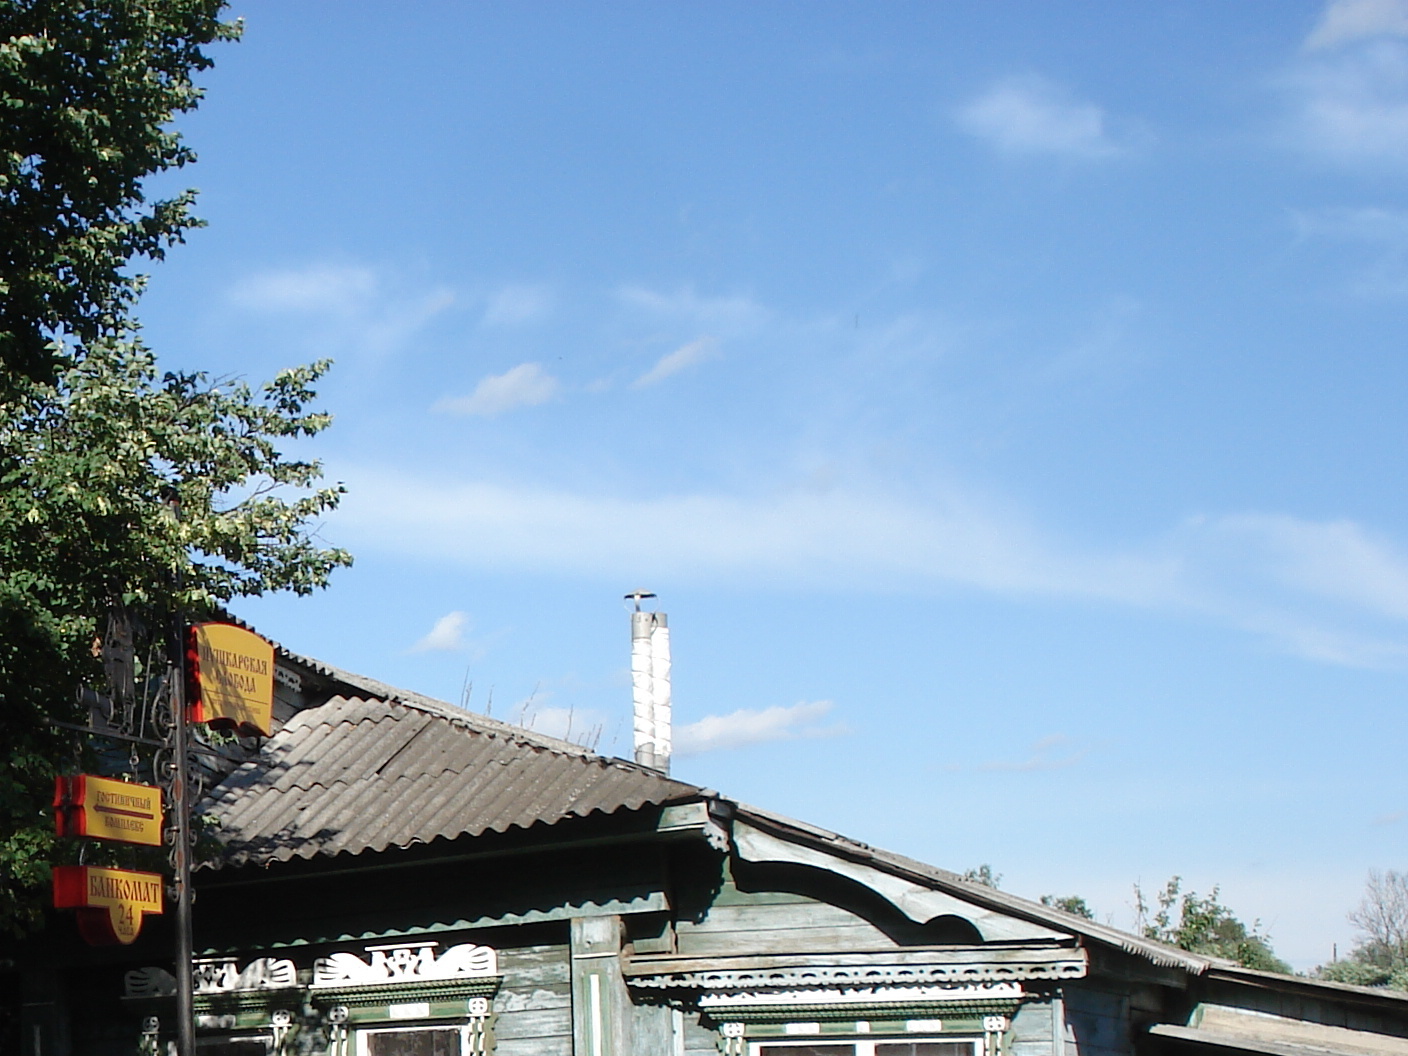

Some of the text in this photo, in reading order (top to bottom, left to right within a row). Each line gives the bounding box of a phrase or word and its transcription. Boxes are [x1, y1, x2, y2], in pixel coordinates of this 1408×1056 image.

[202, 645, 268, 676] ПУШКАРСКАЯ
[215, 668, 257, 693] СЛОБОДА
[96, 790, 151, 810] ГОСТИНИЧНЫЙ
[104, 815, 144, 832] КОМПЛЕКС
[89, 875, 160, 903] БАНКОМАТ
[118, 903, 133, 926] 24
